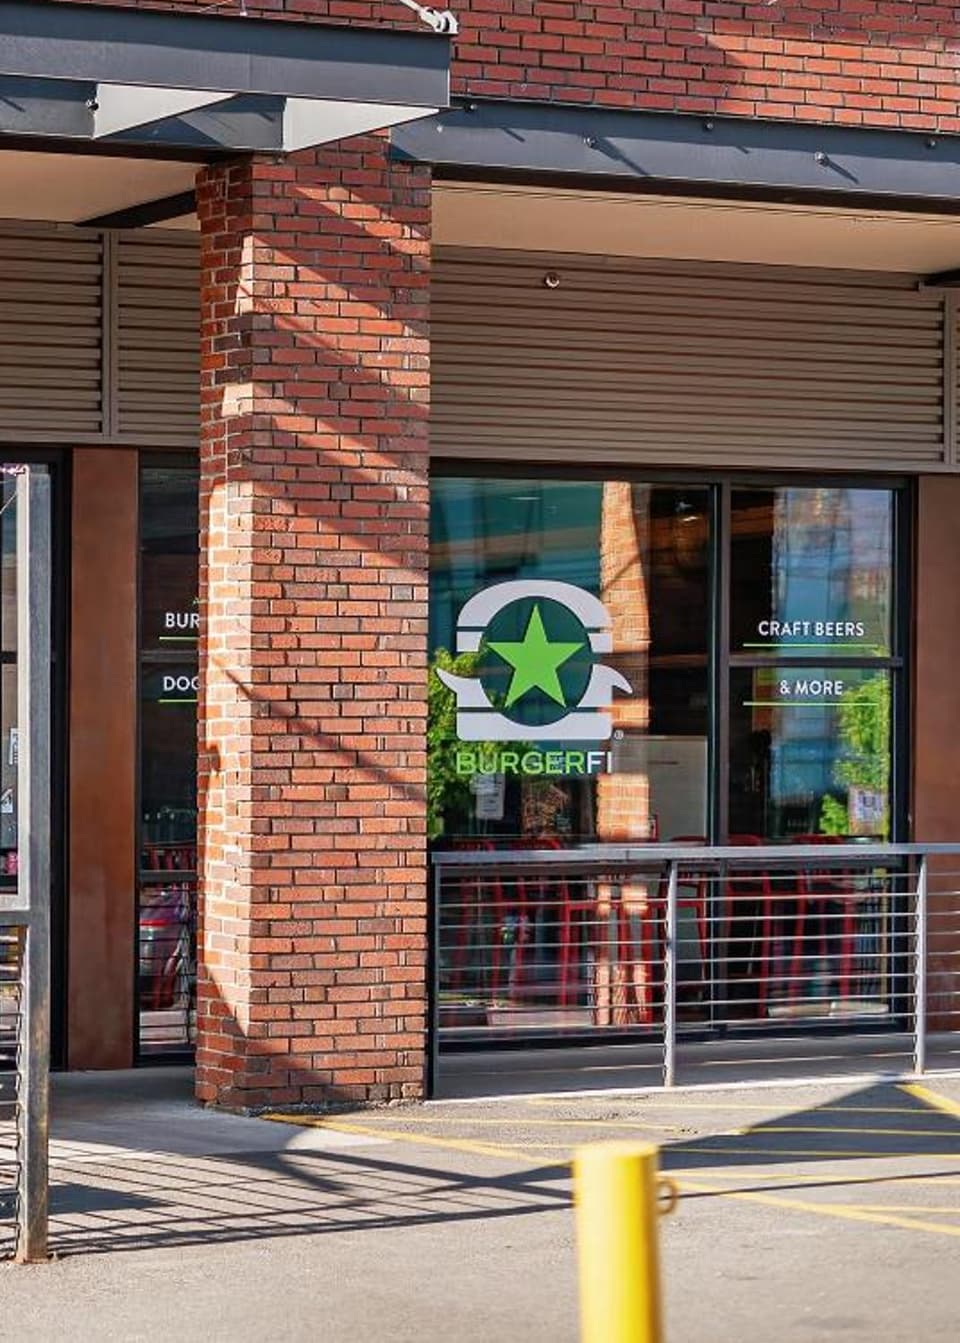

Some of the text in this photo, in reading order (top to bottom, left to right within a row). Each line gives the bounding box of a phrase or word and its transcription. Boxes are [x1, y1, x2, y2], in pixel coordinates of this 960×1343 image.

[758, 621, 865, 637] CRAFT BEERS
[779, 680, 843, 696] & MORE
[456, 751, 612, 775] BURGERFI
